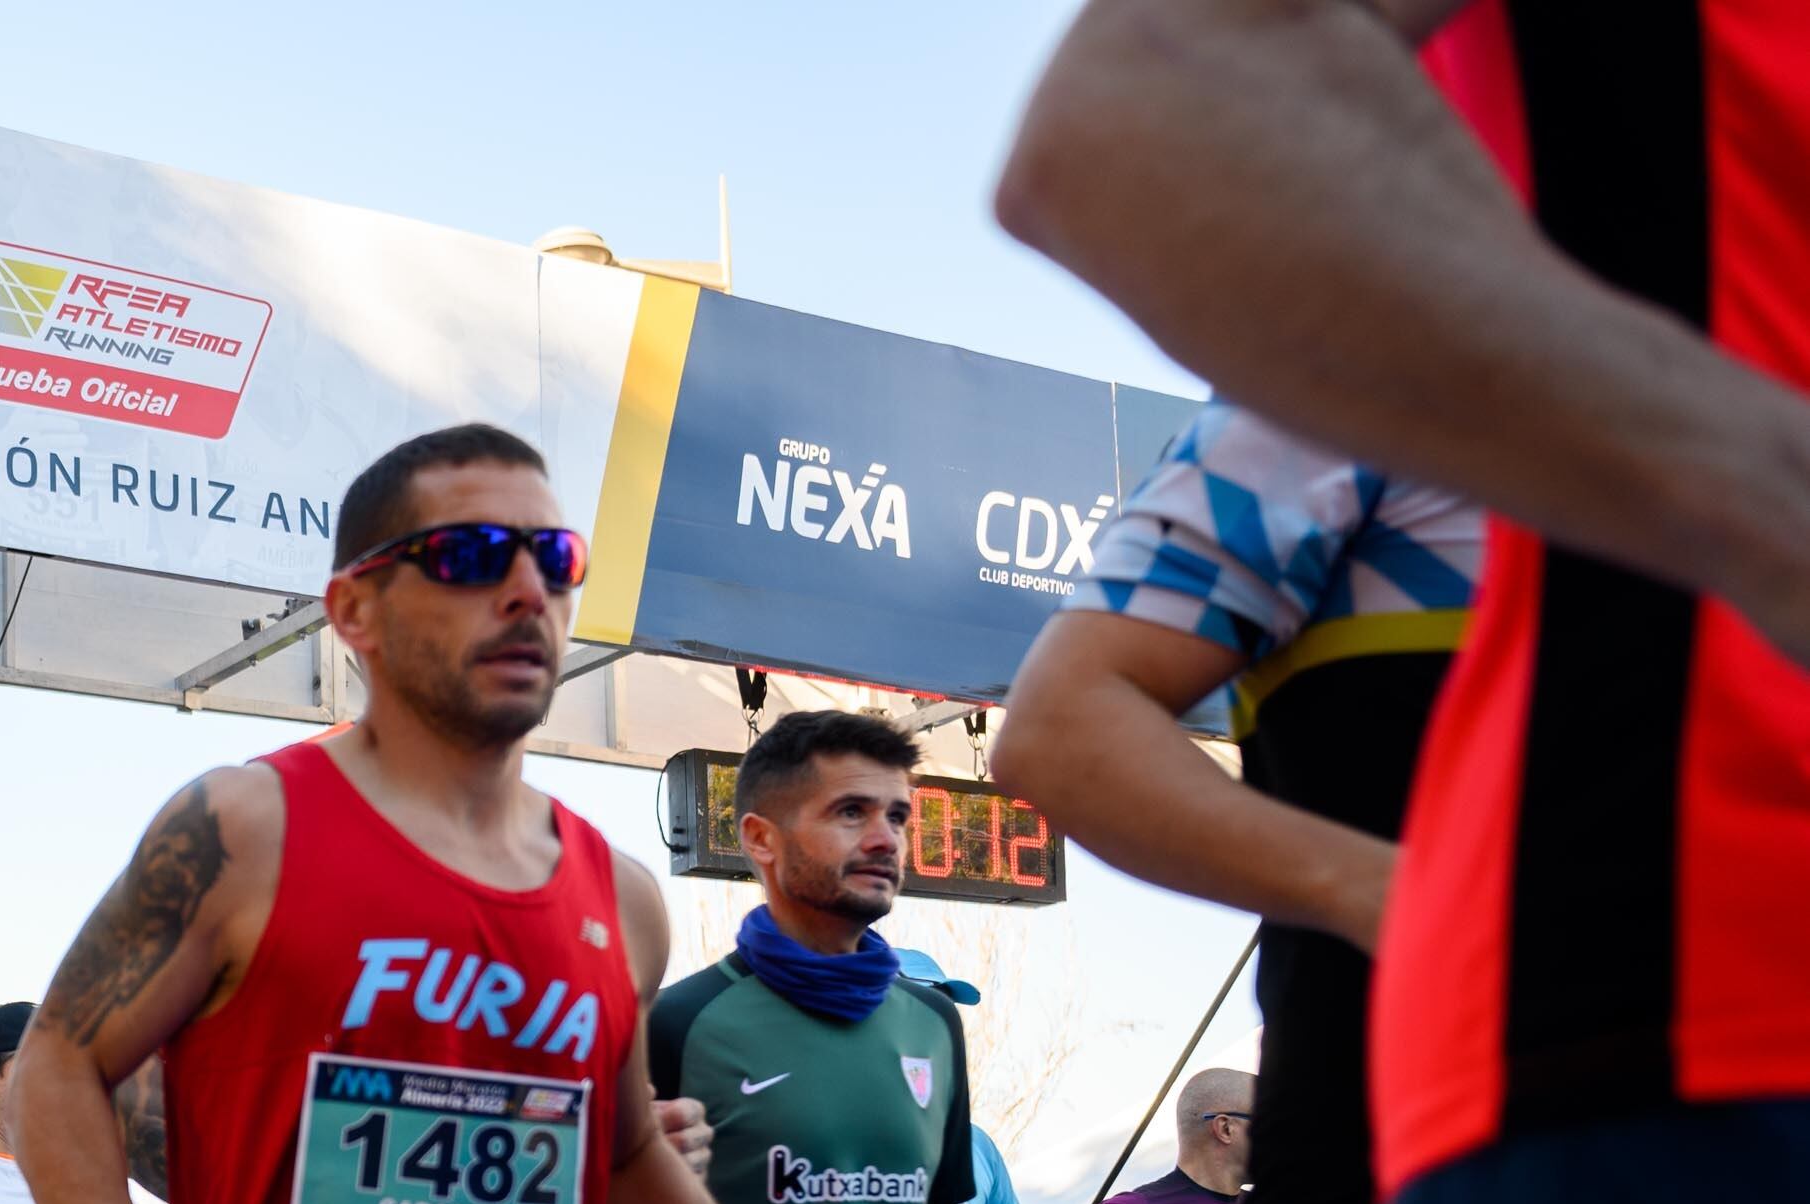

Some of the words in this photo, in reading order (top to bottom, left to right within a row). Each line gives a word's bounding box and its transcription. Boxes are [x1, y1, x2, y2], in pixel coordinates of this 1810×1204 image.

[68, 273, 191, 318] RFEA
[44, 326, 175, 366] RUNNING
[56, 303, 243, 358] ATLETISMO
[80, 377, 179, 418] Oficial
[779, 438, 830, 464] GRUPO
[112, 462, 237, 524] RUIZ
[736, 453, 911, 559] NEXA
[976, 491, 1115, 575] CDX
[979, 567, 1009, 585] CLUB
[1011, 573, 1075, 596] DEPORTIVO
[341, 938, 599, 1063] FURIA
[772, 1149, 926, 1200] Kutxabank
